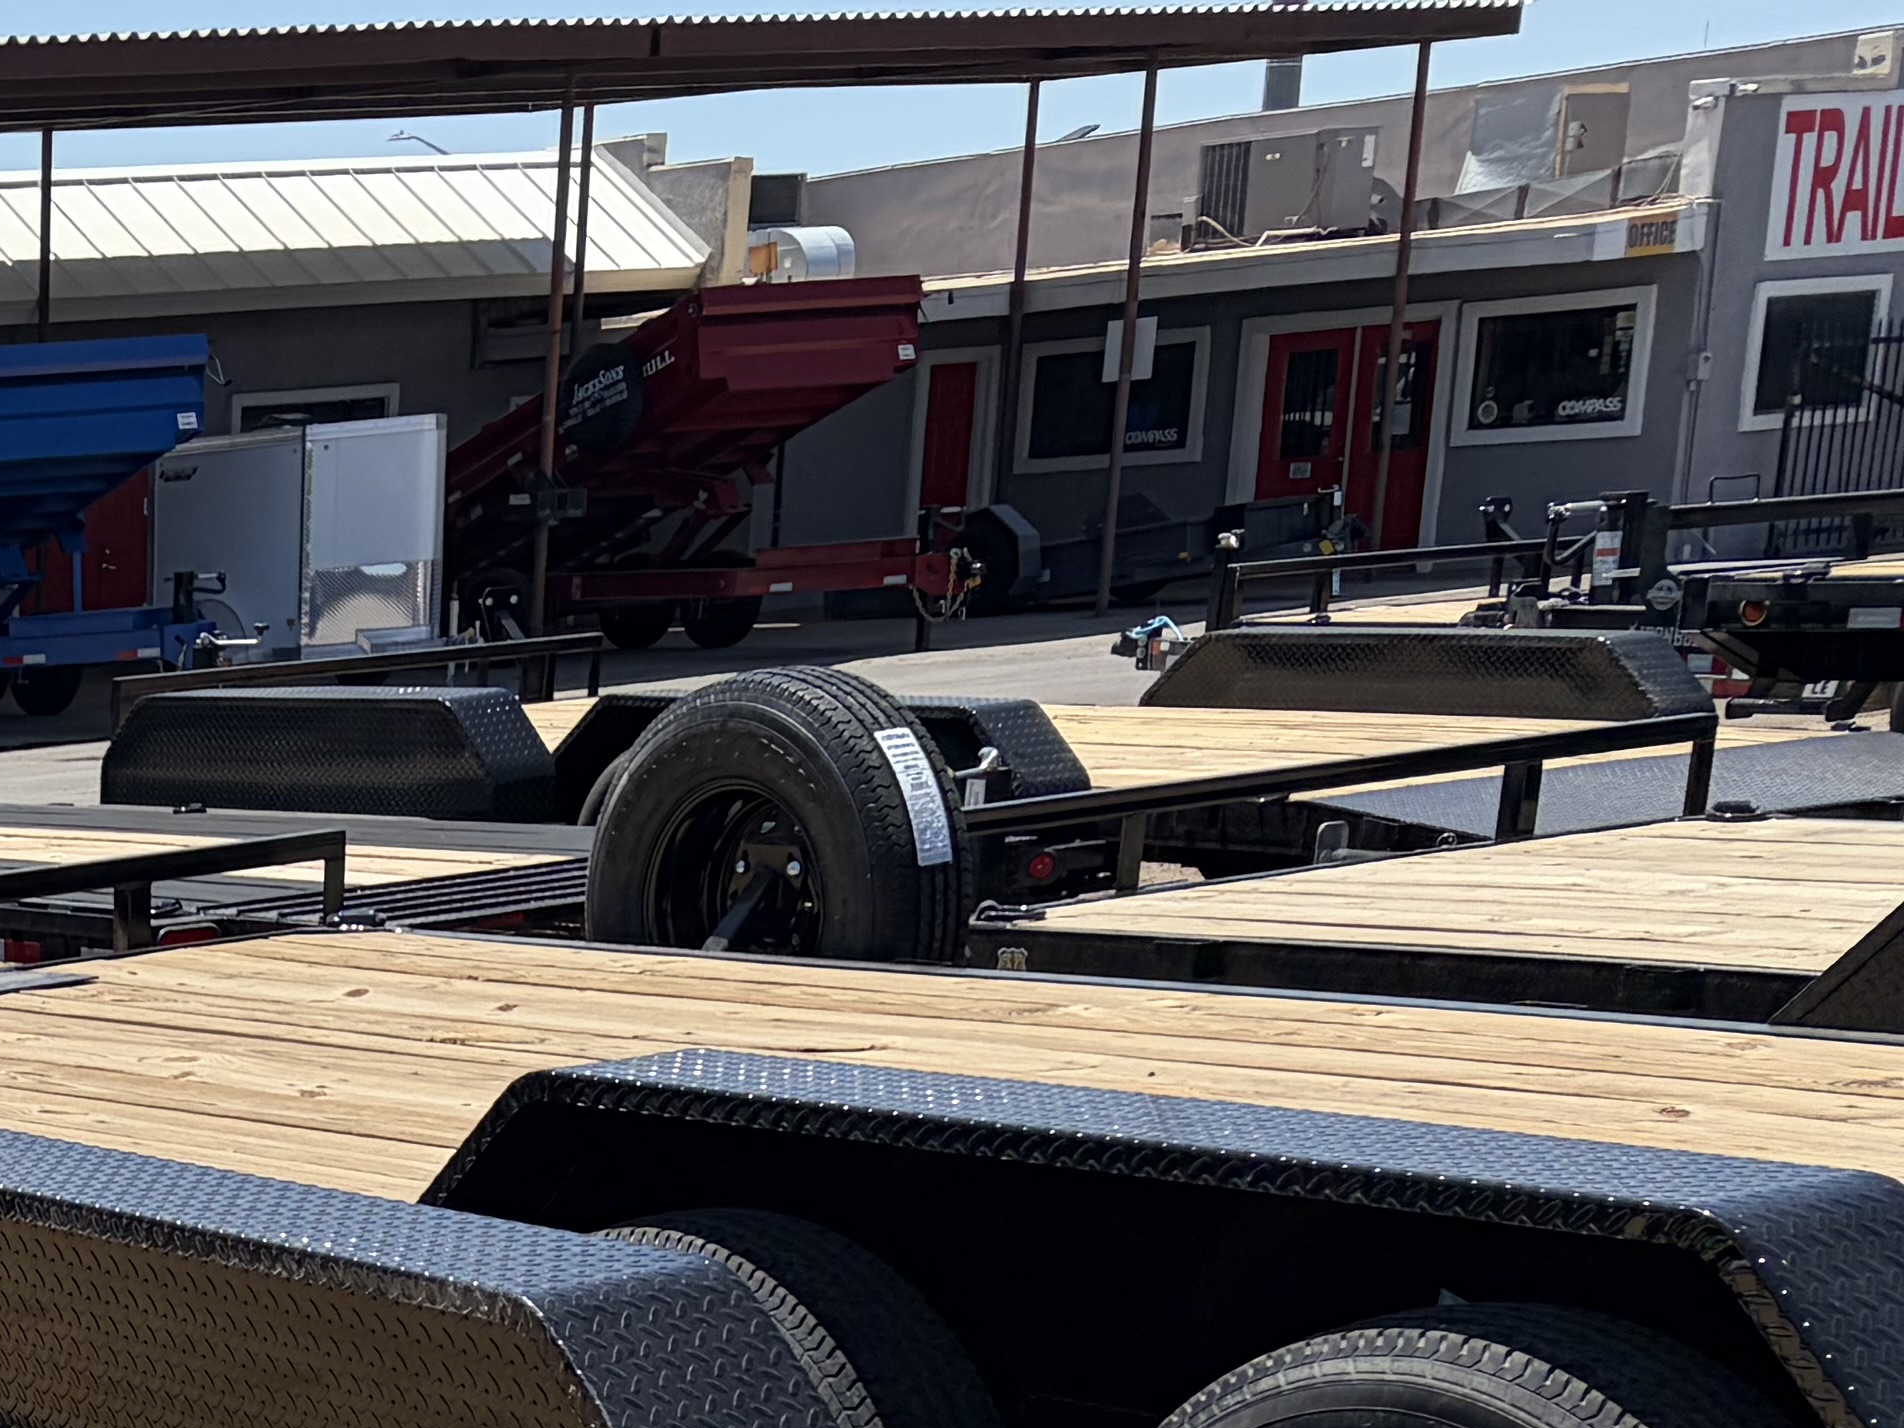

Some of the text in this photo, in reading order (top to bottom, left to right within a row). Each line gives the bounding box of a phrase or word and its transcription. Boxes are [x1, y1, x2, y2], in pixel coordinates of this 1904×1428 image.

[1627, 220, 1677, 248] OFFICE
[1558, 397, 1622, 416] COMPASS
[1125, 428, 1178, 445] COMPASS
